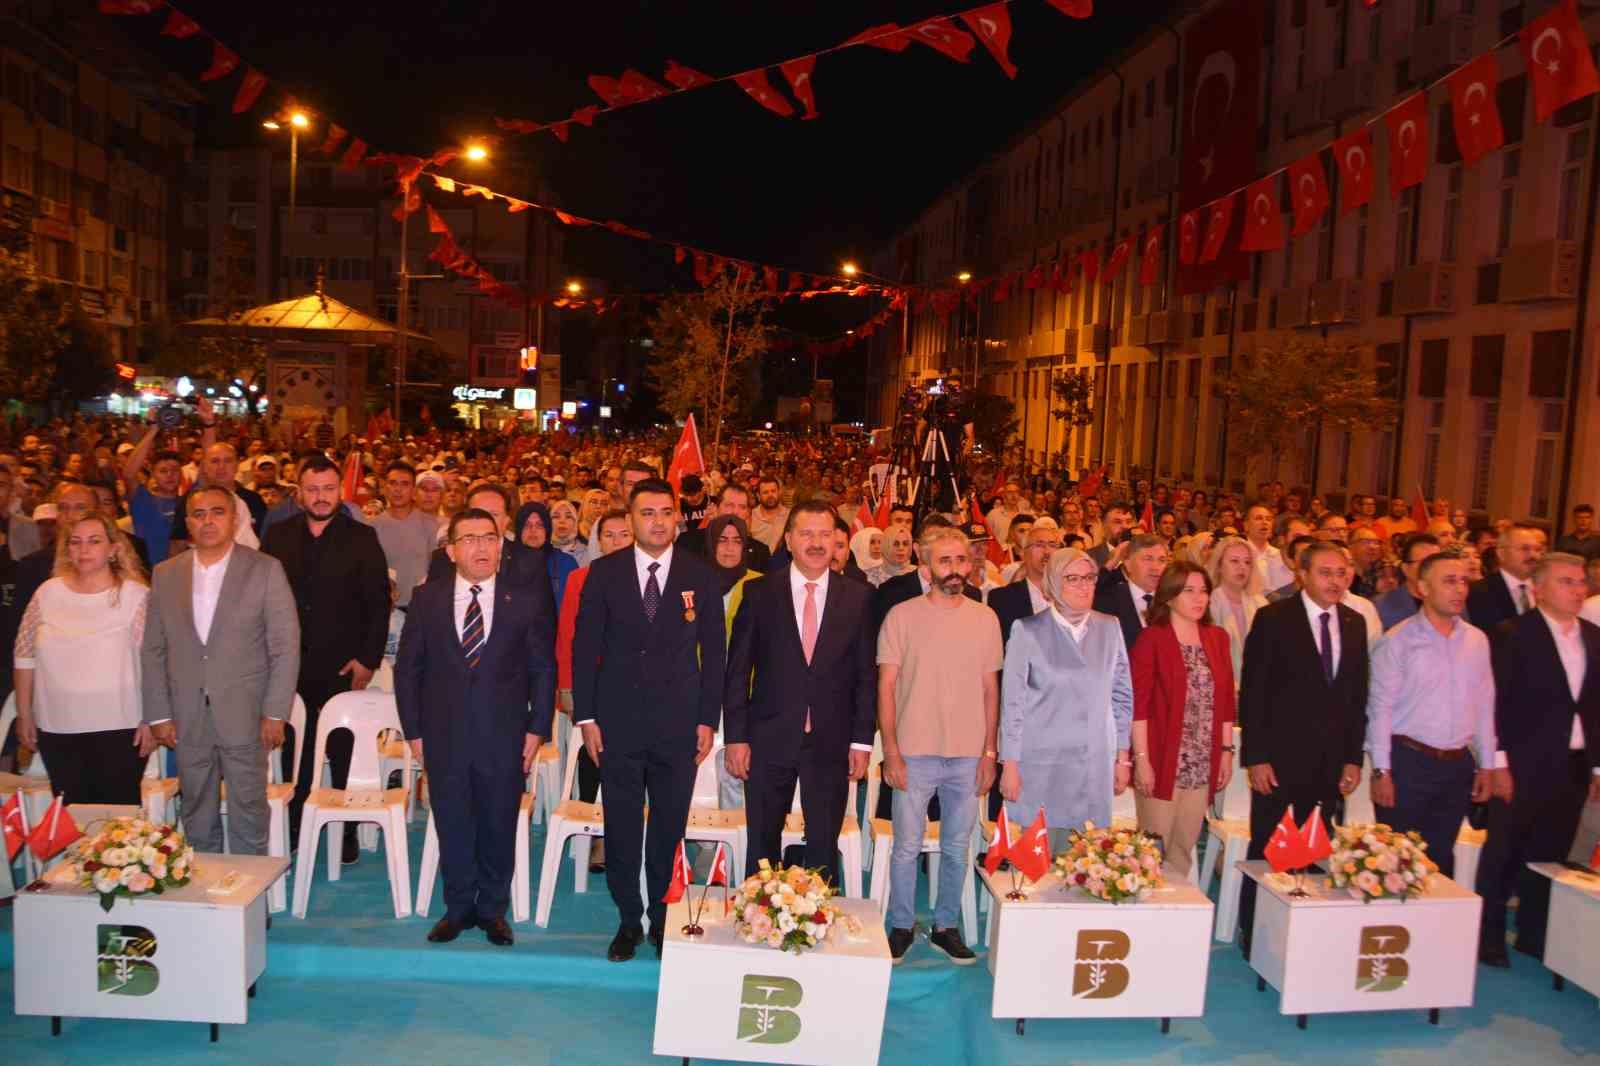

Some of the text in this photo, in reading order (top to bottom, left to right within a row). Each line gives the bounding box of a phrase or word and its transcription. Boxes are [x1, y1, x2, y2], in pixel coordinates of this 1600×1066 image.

[97, 924, 160, 996] B
[1072, 929, 1130, 999] B
[1355, 925, 1411, 992] B
[737, 974, 803, 1044] B
